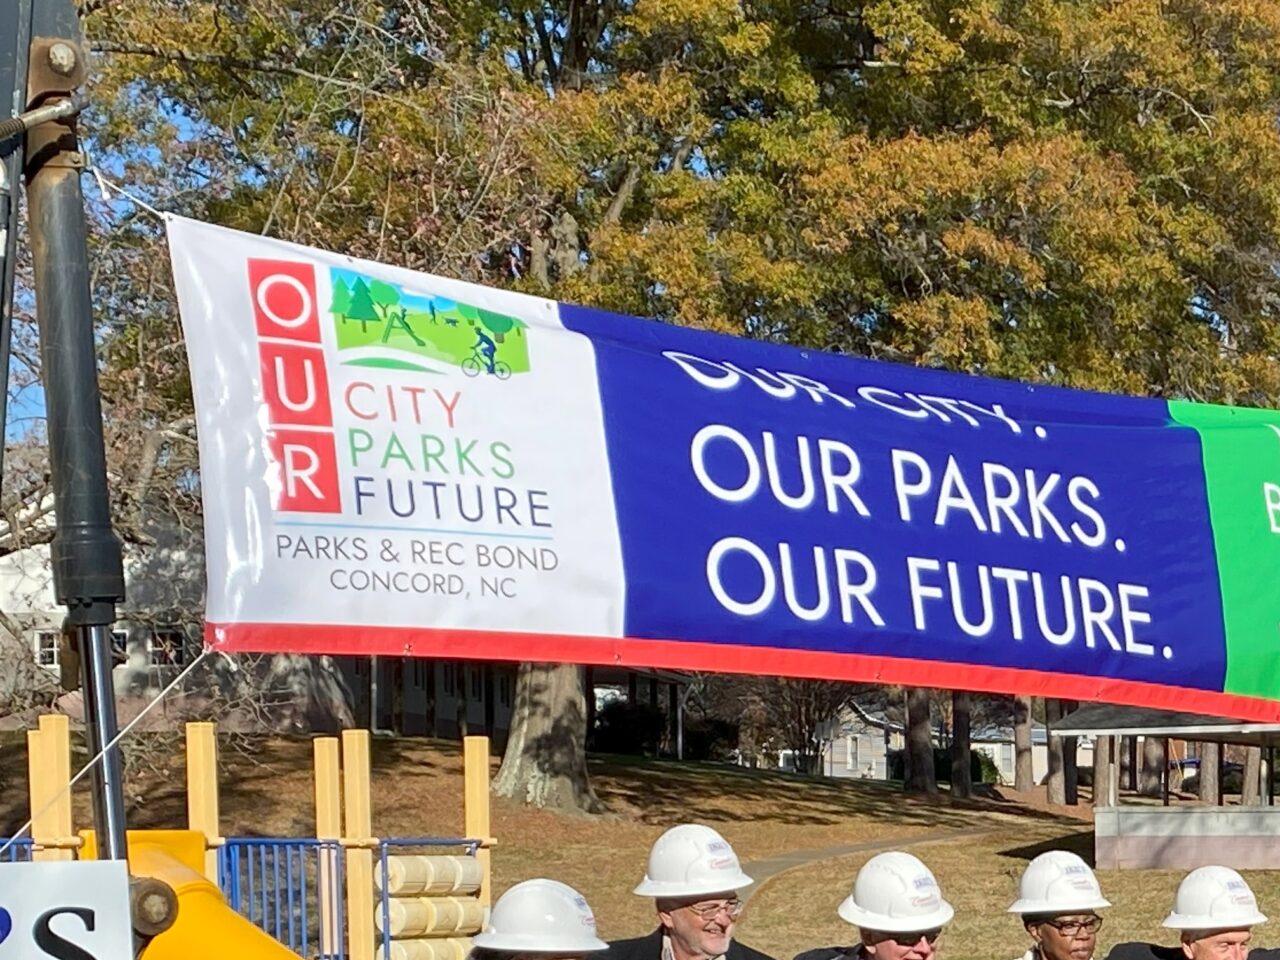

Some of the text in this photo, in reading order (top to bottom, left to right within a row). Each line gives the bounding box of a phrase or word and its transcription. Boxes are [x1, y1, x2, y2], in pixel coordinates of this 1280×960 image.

[256, 274, 325, 500] OUR
[344, 381, 462, 428] CITY
[664, 351, 1047, 439] OUR CITY.
[348, 427, 515, 479] PARKS
[353, 476, 553, 528] FUTURE
[690, 424, 1126, 552] OUR PARKS.
[276, 534, 559, 571] PARKS & REC BOND
[329, 568, 517, 600] CONCORD, NC
[706, 536, 1173, 660] OUR FUTURE.
